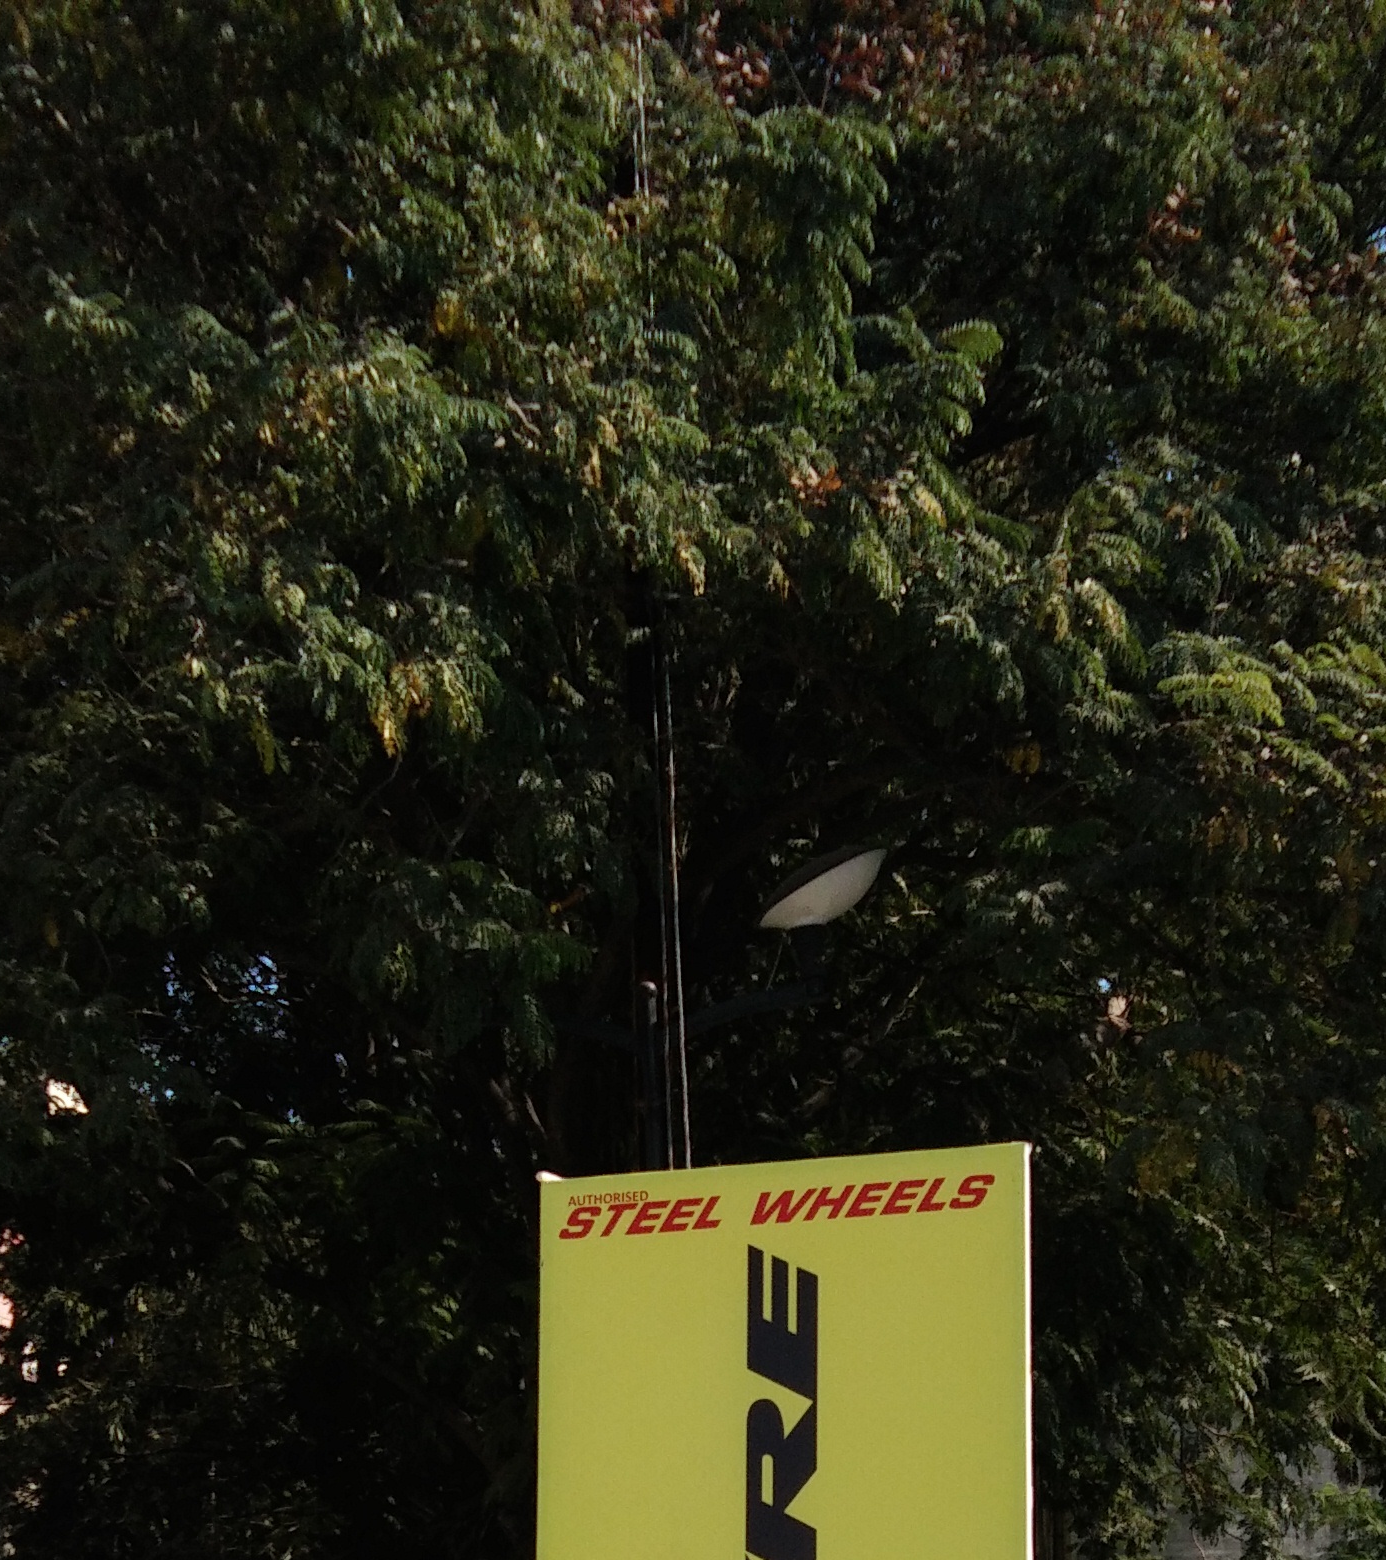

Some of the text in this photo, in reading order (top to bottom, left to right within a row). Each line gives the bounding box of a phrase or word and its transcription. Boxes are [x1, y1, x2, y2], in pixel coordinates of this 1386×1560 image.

[558, 1174, 995, 1240] STEEL WHEELS
[567, 1190, 649, 1207] AUTHORISED
